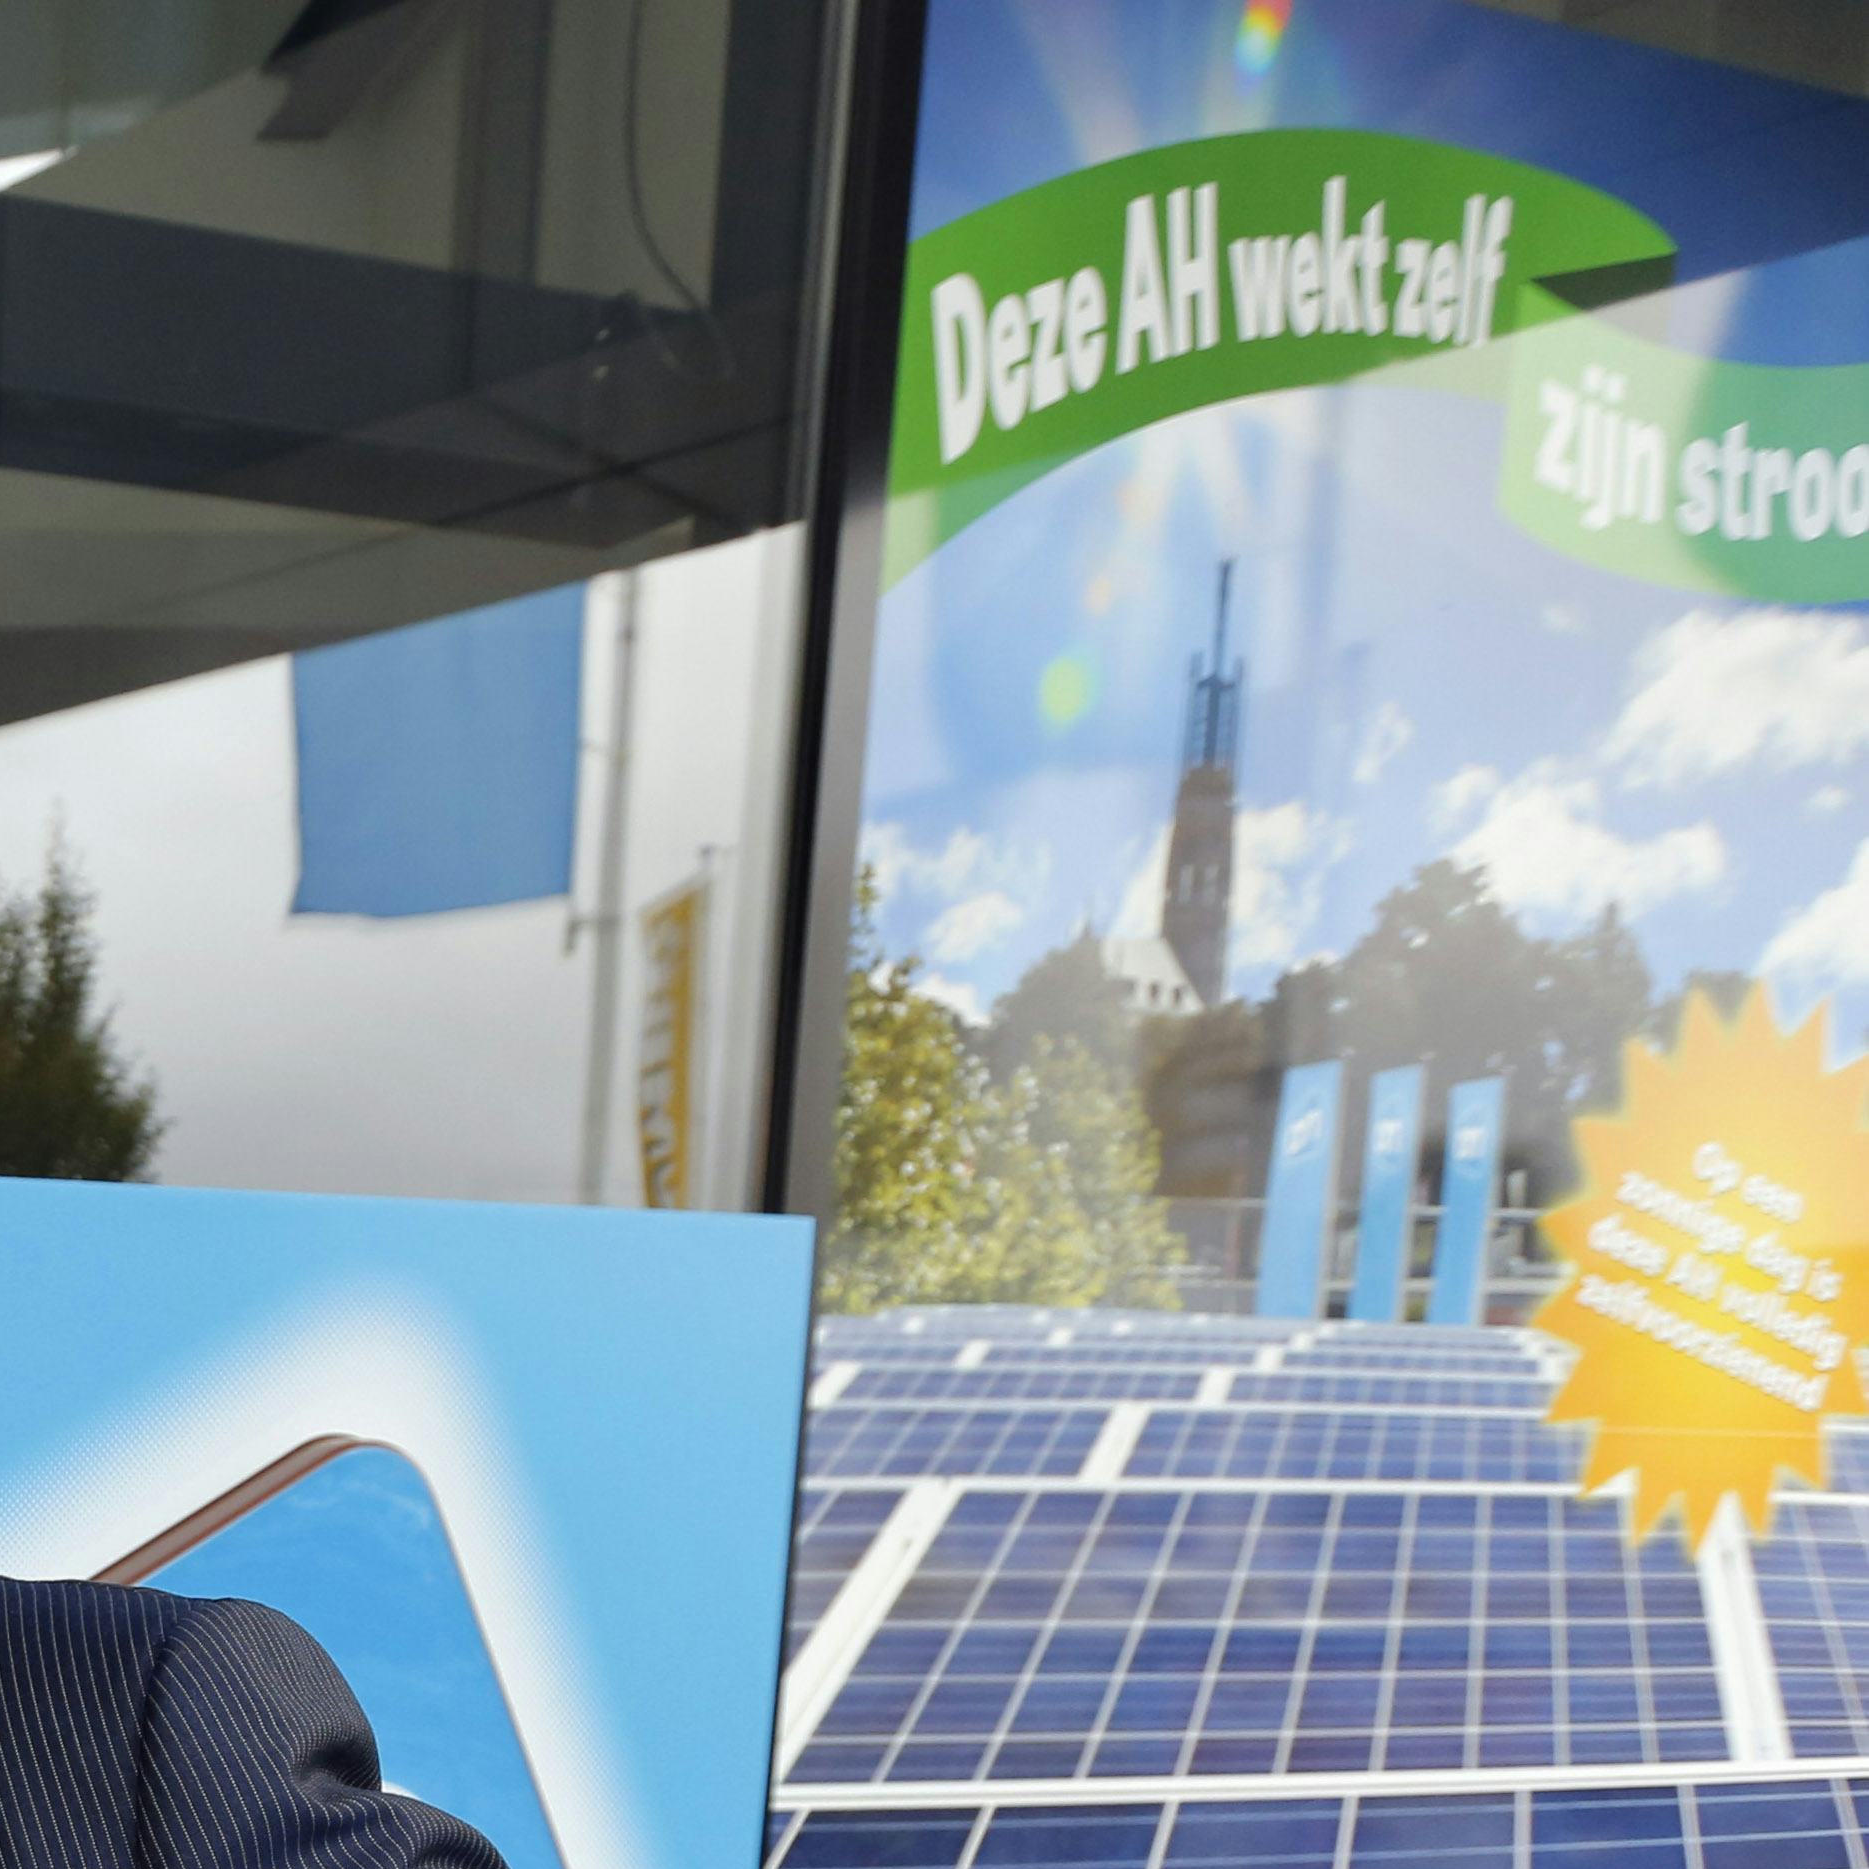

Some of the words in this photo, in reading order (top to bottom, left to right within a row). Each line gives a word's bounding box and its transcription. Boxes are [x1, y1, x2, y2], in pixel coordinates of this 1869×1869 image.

[930, 264, 1107, 467] Deze
[1116, 180, 1219, 376] AH
[1228, 175, 1388, 344] wekt
[1392, 194, 1515, 350] zelf
[1535, 366, 1664, 531] zijn
